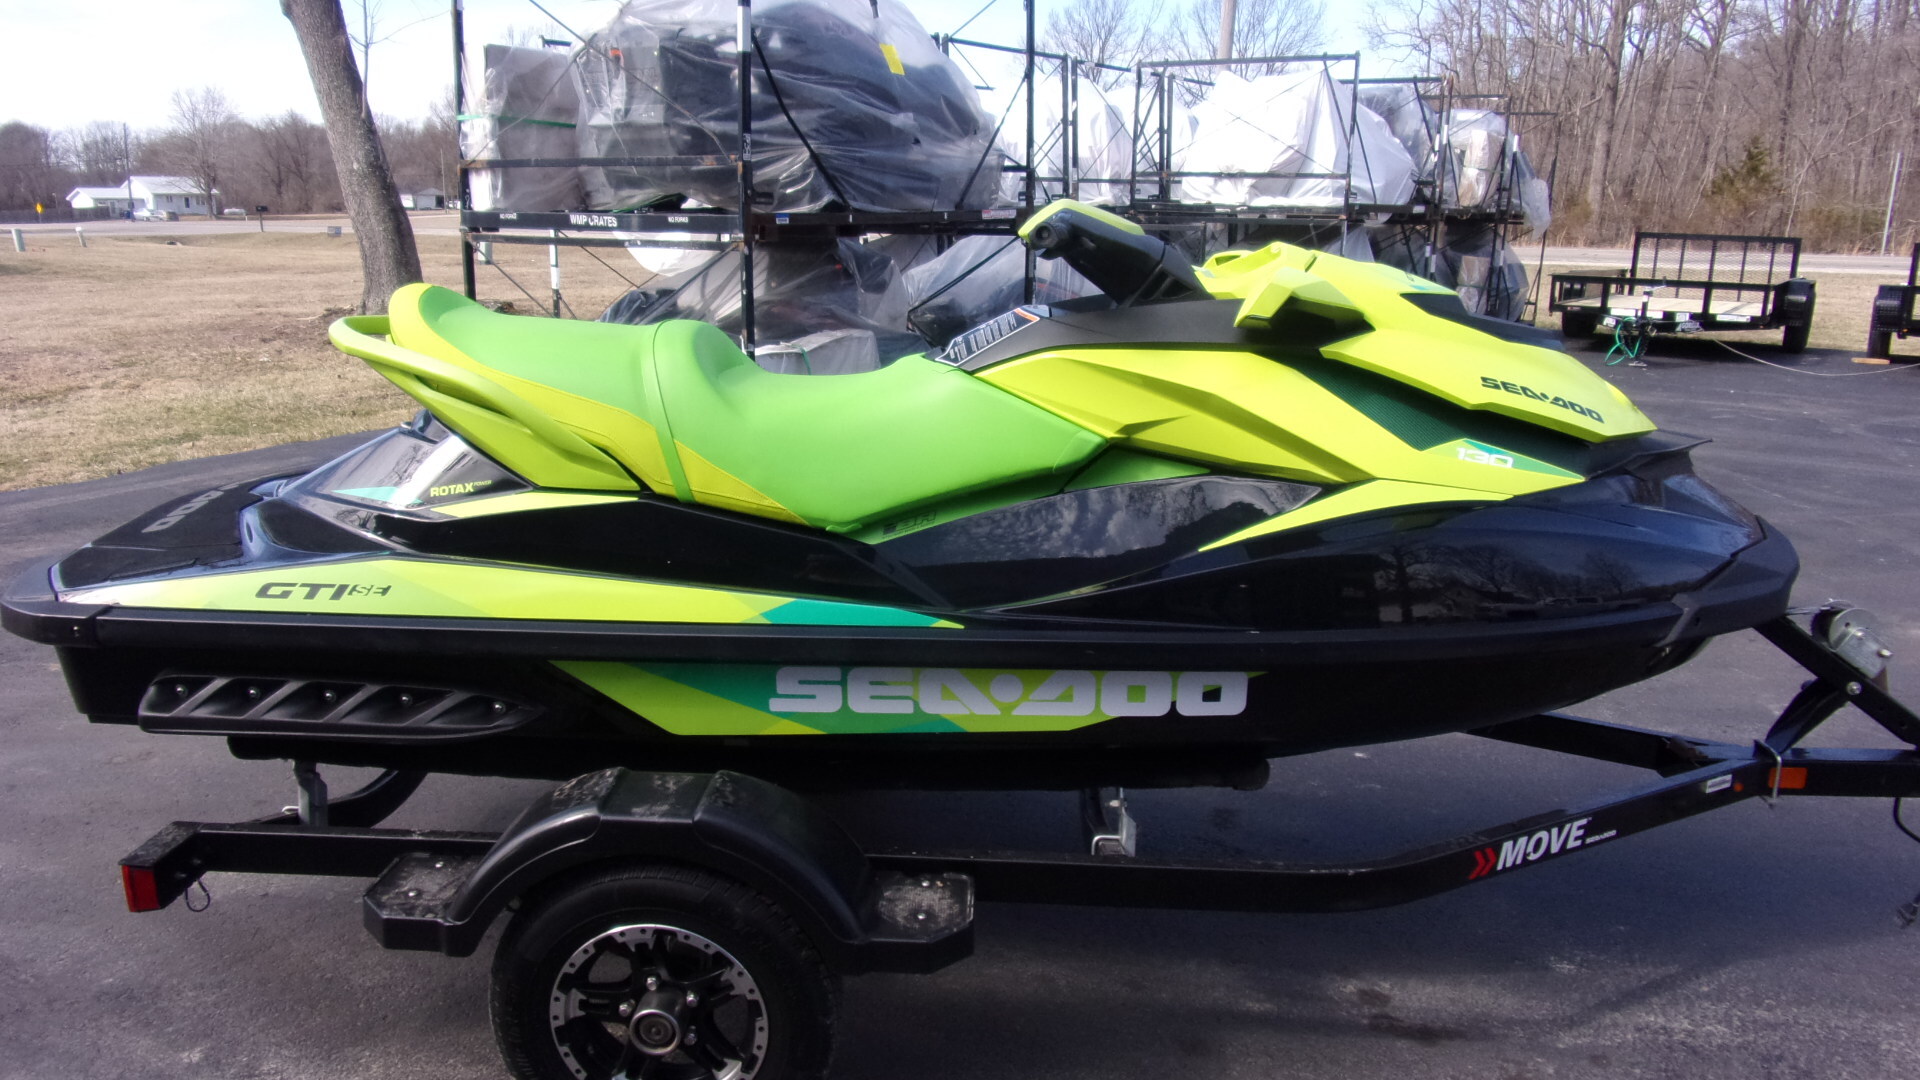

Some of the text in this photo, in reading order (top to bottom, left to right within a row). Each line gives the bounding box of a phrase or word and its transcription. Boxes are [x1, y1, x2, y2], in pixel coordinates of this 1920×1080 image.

[569, 214, 618, 227] WMP CRATES
[1457, 447, 1513, 468] 130
[430, 482, 474, 497] ROTAX
[255, 582, 350, 600] GTI
[1497, 818, 1589, 871] MOVE
